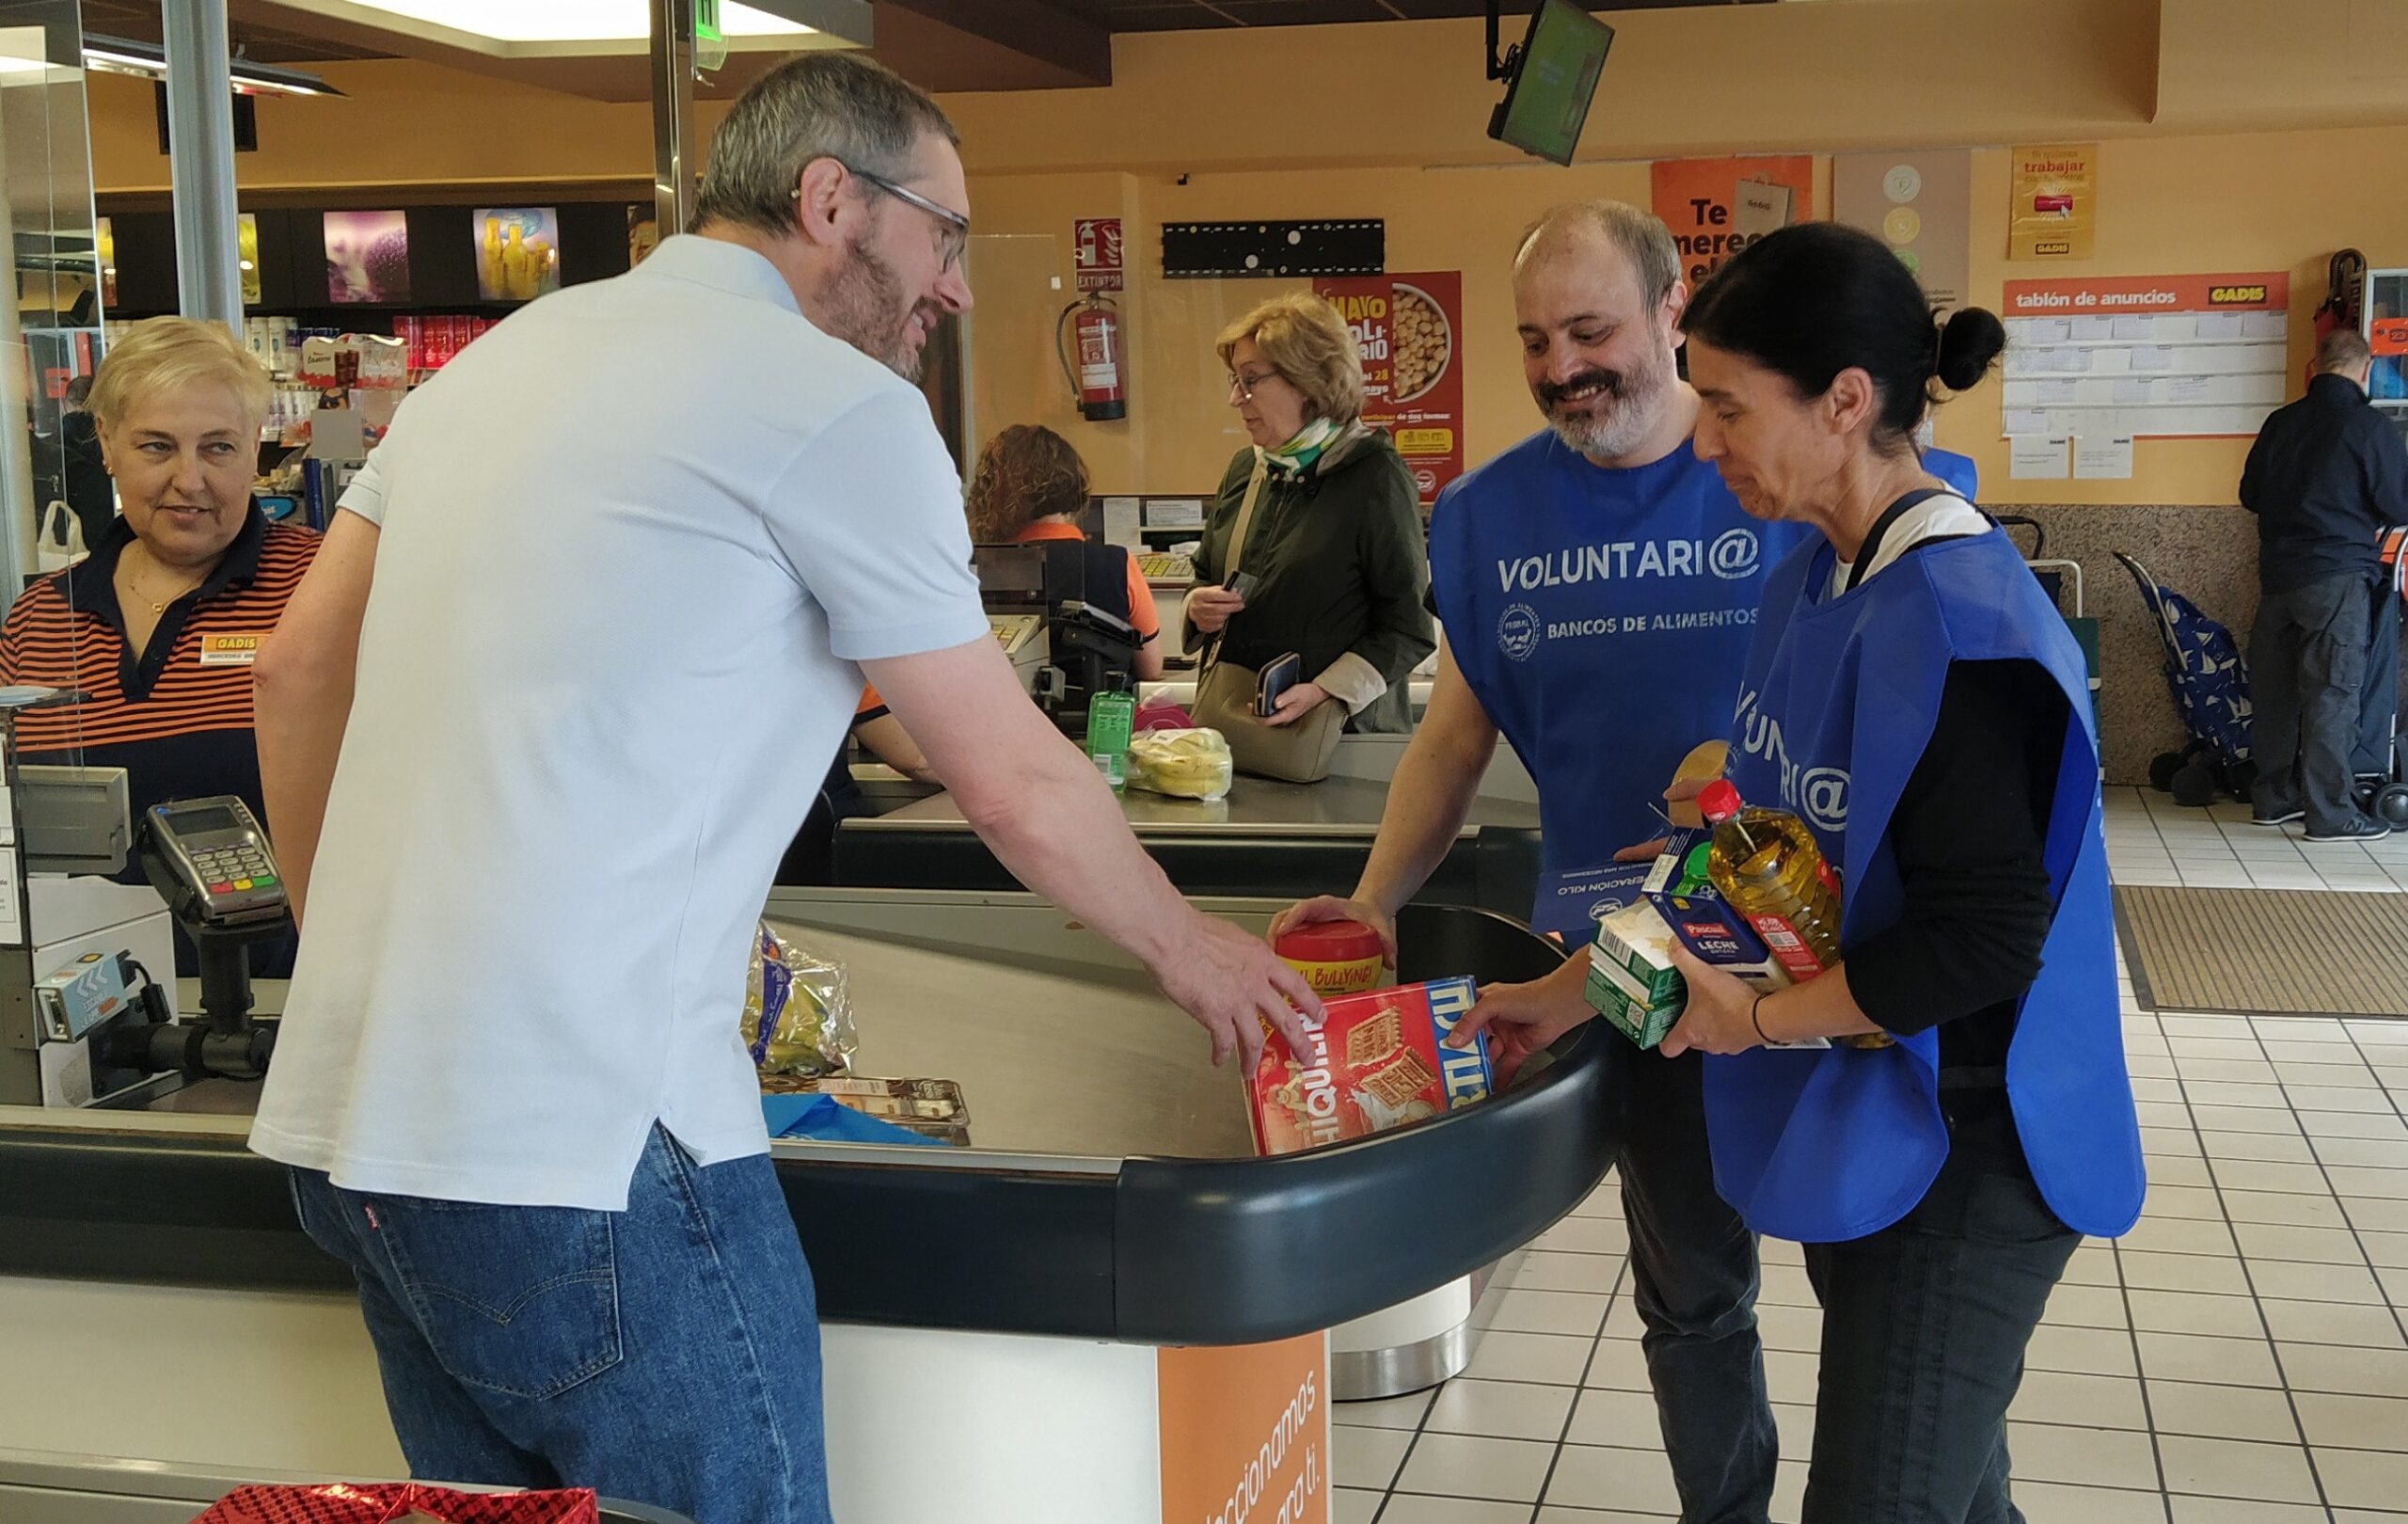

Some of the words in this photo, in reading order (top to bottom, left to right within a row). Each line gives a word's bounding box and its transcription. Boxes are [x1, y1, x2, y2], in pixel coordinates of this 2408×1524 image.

[2024, 160, 2085, 175] trabajar
[1689, 198, 1727, 226] Te
[1078, 273, 1122, 287] EXTINTOR
[2016, 292, 2070, 308] tablón
[2075, 291, 2096, 307] de
[2100, 289, 2176, 306] anuncios
[2211, 287, 2264, 302] GADIS
[1374, 369, 1388, 381] 28
[1497, 528, 1760, 594] VOLUNTARI@
[1547, 616, 1617, 640] BANCOS
[1624, 614, 1647, 633] DE
[1652, 608, 1760, 631] ALIMENTOS
[217, 638, 256, 648] GADIS
[1558, 883, 1586, 896] KILO
[1589, 875, 1646, 894] ERACIÓN
[1687, 923, 1726, 934] Pascual
[1697, 941, 1739, 950] LECHE
